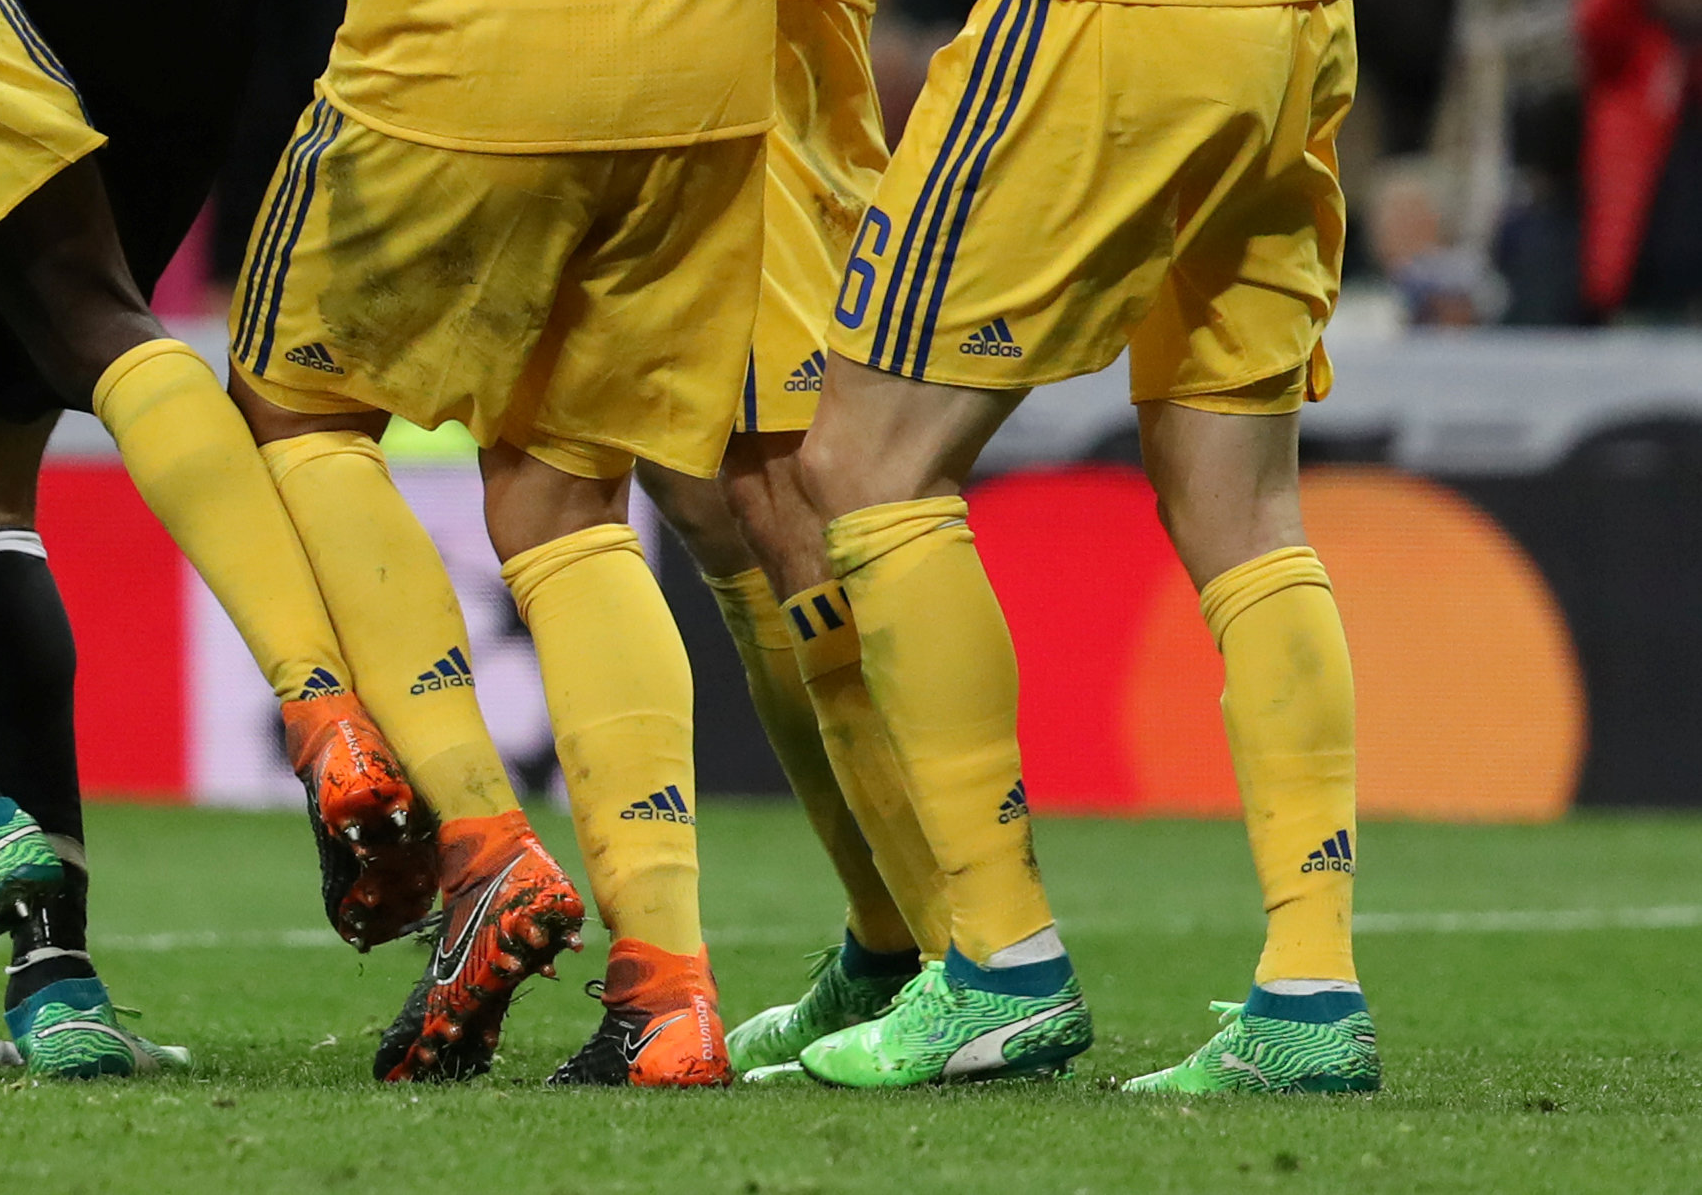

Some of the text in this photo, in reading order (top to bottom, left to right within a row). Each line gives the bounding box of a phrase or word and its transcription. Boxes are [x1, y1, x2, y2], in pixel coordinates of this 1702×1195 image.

[835, 205, 892, 330] 6
[959, 340, 1023, 358] adidas
[284, 351, 345, 375] adidas
